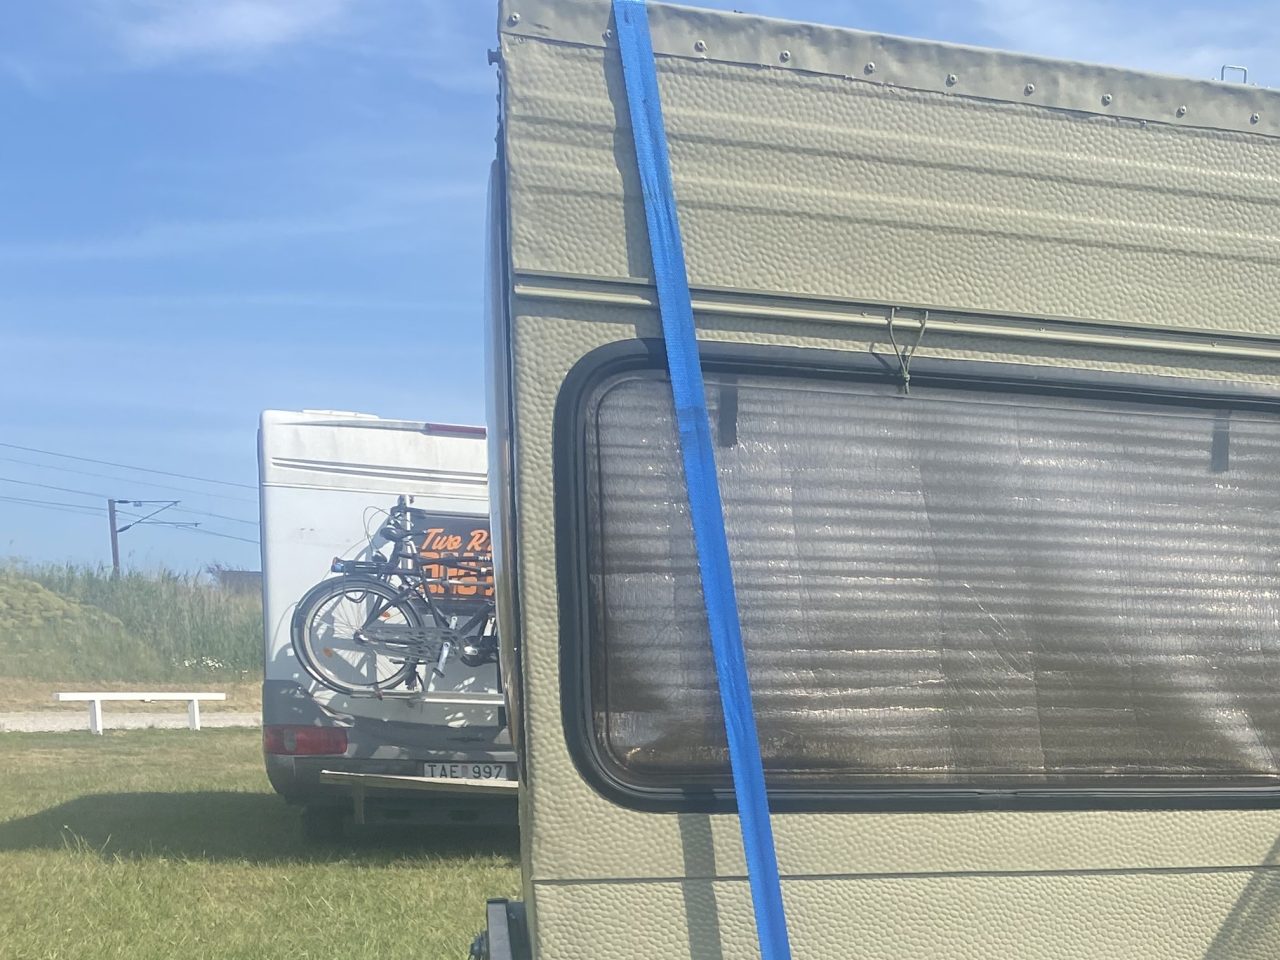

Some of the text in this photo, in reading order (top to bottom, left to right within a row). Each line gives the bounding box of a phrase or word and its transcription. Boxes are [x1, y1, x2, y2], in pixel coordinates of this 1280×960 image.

[421, 527, 463, 551] Two
[427, 764, 503, 779] TAE 997
